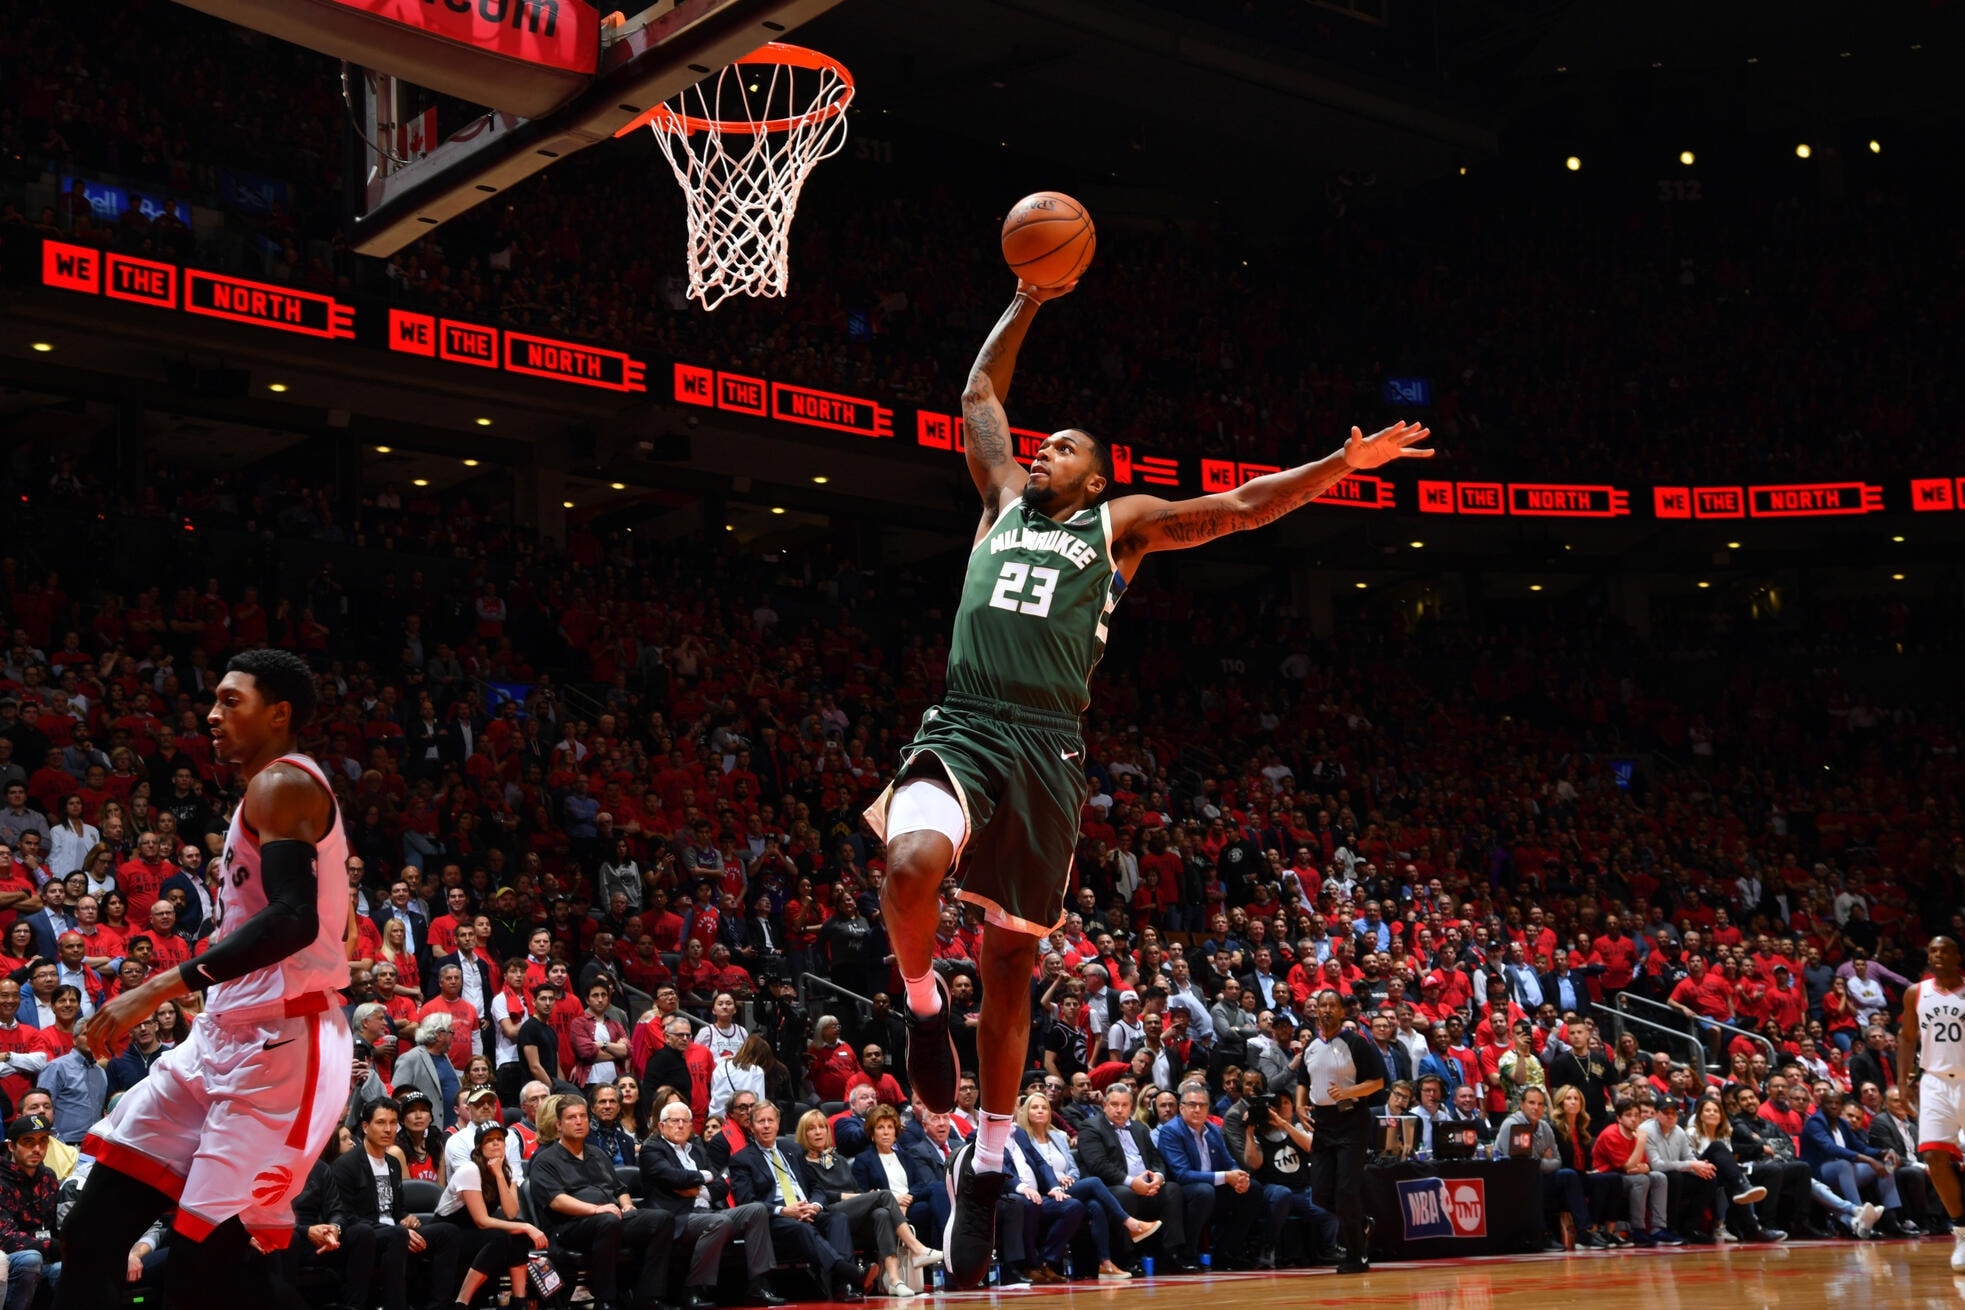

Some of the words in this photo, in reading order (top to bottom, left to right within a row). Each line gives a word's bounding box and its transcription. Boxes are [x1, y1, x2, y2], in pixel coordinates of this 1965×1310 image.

[56, 253, 91, 280] WE
[118, 264, 166, 295] THE
[212, 283, 301, 323] NORTH
[400, 321, 428, 344] WE
[450, 330, 489, 356] THE
[528, 343, 601, 377] NORTH
[683, 374, 707, 396] WE
[725, 380, 759, 406] THE
[792, 393, 856, 425] NORTH
[925, 419, 946, 440] WE
[1209, 468, 1230, 485] WE
[1426, 488, 1448, 505] WE
[1464, 489, 1497, 507] THE
[1527, 490, 1592, 510] NORTH
[1662, 494, 1685, 511] WE
[1701, 494, 1737, 511] THE
[1769, 490, 1840, 511] NORTH
[1921, 486, 1946, 501] WE
[990, 527, 1098, 571] MILWAUKEE
[988, 561, 1061, 618] 23
[1934, 1022, 1962, 1043] 20
[1273, 1153, 1299, 1168] TNT
[1407, 1190, 1441, 1227] NBA
[1454, 1201, 1481, 1219] TNT
